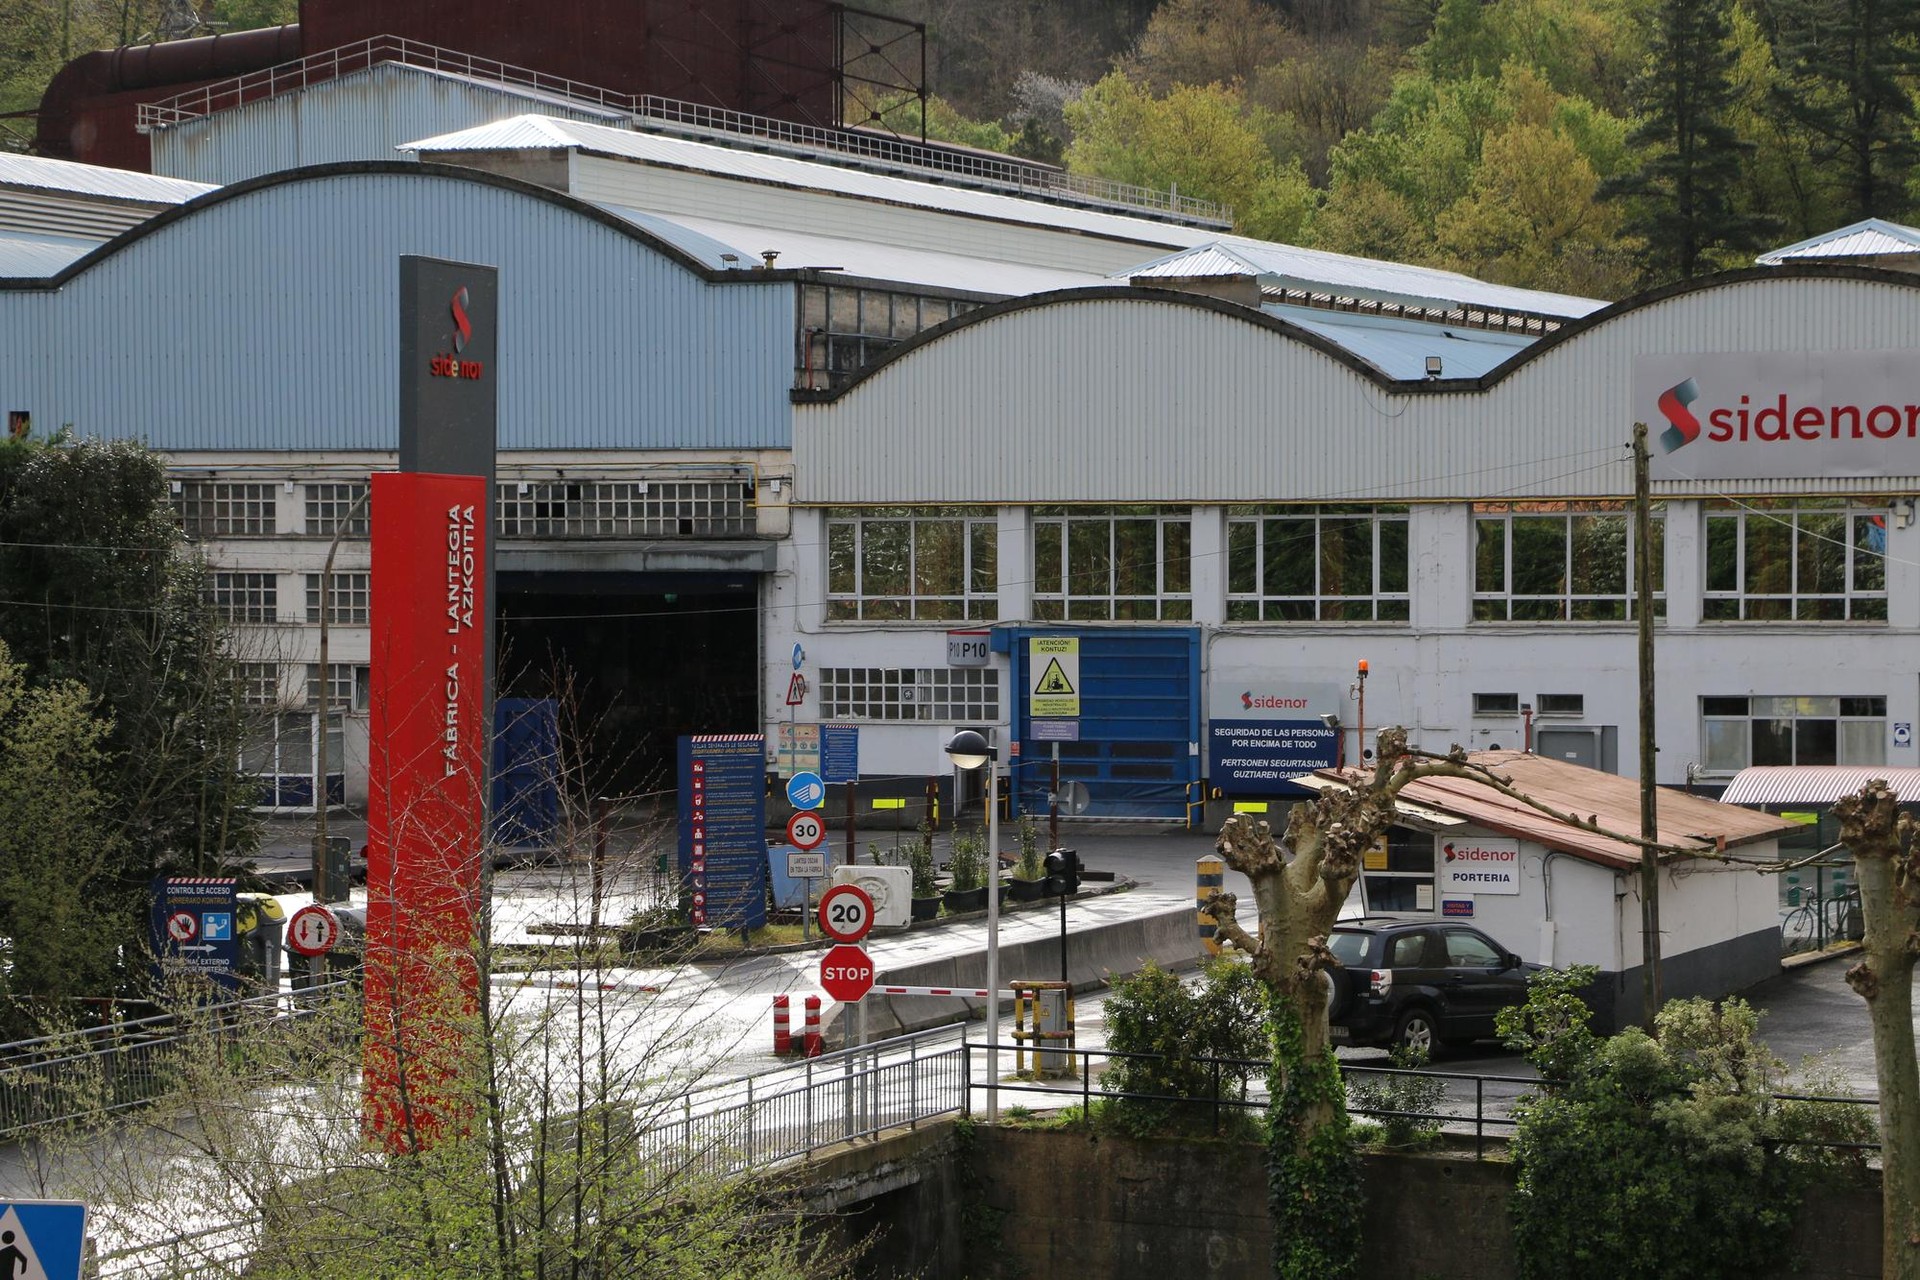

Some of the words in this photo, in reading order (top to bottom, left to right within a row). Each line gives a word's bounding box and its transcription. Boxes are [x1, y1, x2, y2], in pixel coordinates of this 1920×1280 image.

[431, 354, 482, 379] sidenor
[448, 504, 461, 633] LANTEGIA
[462, 506, 474, 628] AZKOITIA
[962, 642, 987, 658] P10
[1254, 696, 1308, 708] sidenor
[442, 663, 459, 776] FÁBRICA
[1214, 728, 1260, 736] SEGURIDAD
[1261, 728, 1273, 737] DE
[1274, 729, 1290, 737] LAS
[1291, 729, 1334, 737] PERSONAS
[1232, 740, 1249, 748] POR
[1250, 740, 1280, 748] ENCIMA
[1294, 740, 1316, 748] TODO
[1221, 759, 1268, 767] PERTSONEN
[1270, 759, 1328, 768] SEGURTASUNA
[1233, 770, 1278, 779] GUZTIAREN
[796, 824, 817, 837] 30
[1458, 848, 1516, 861] sidenor
[1453, 873, 1510, 882] PORTERIA
[832, 904, 861, 923] 20
[825, 968, 869, 981] STOP
